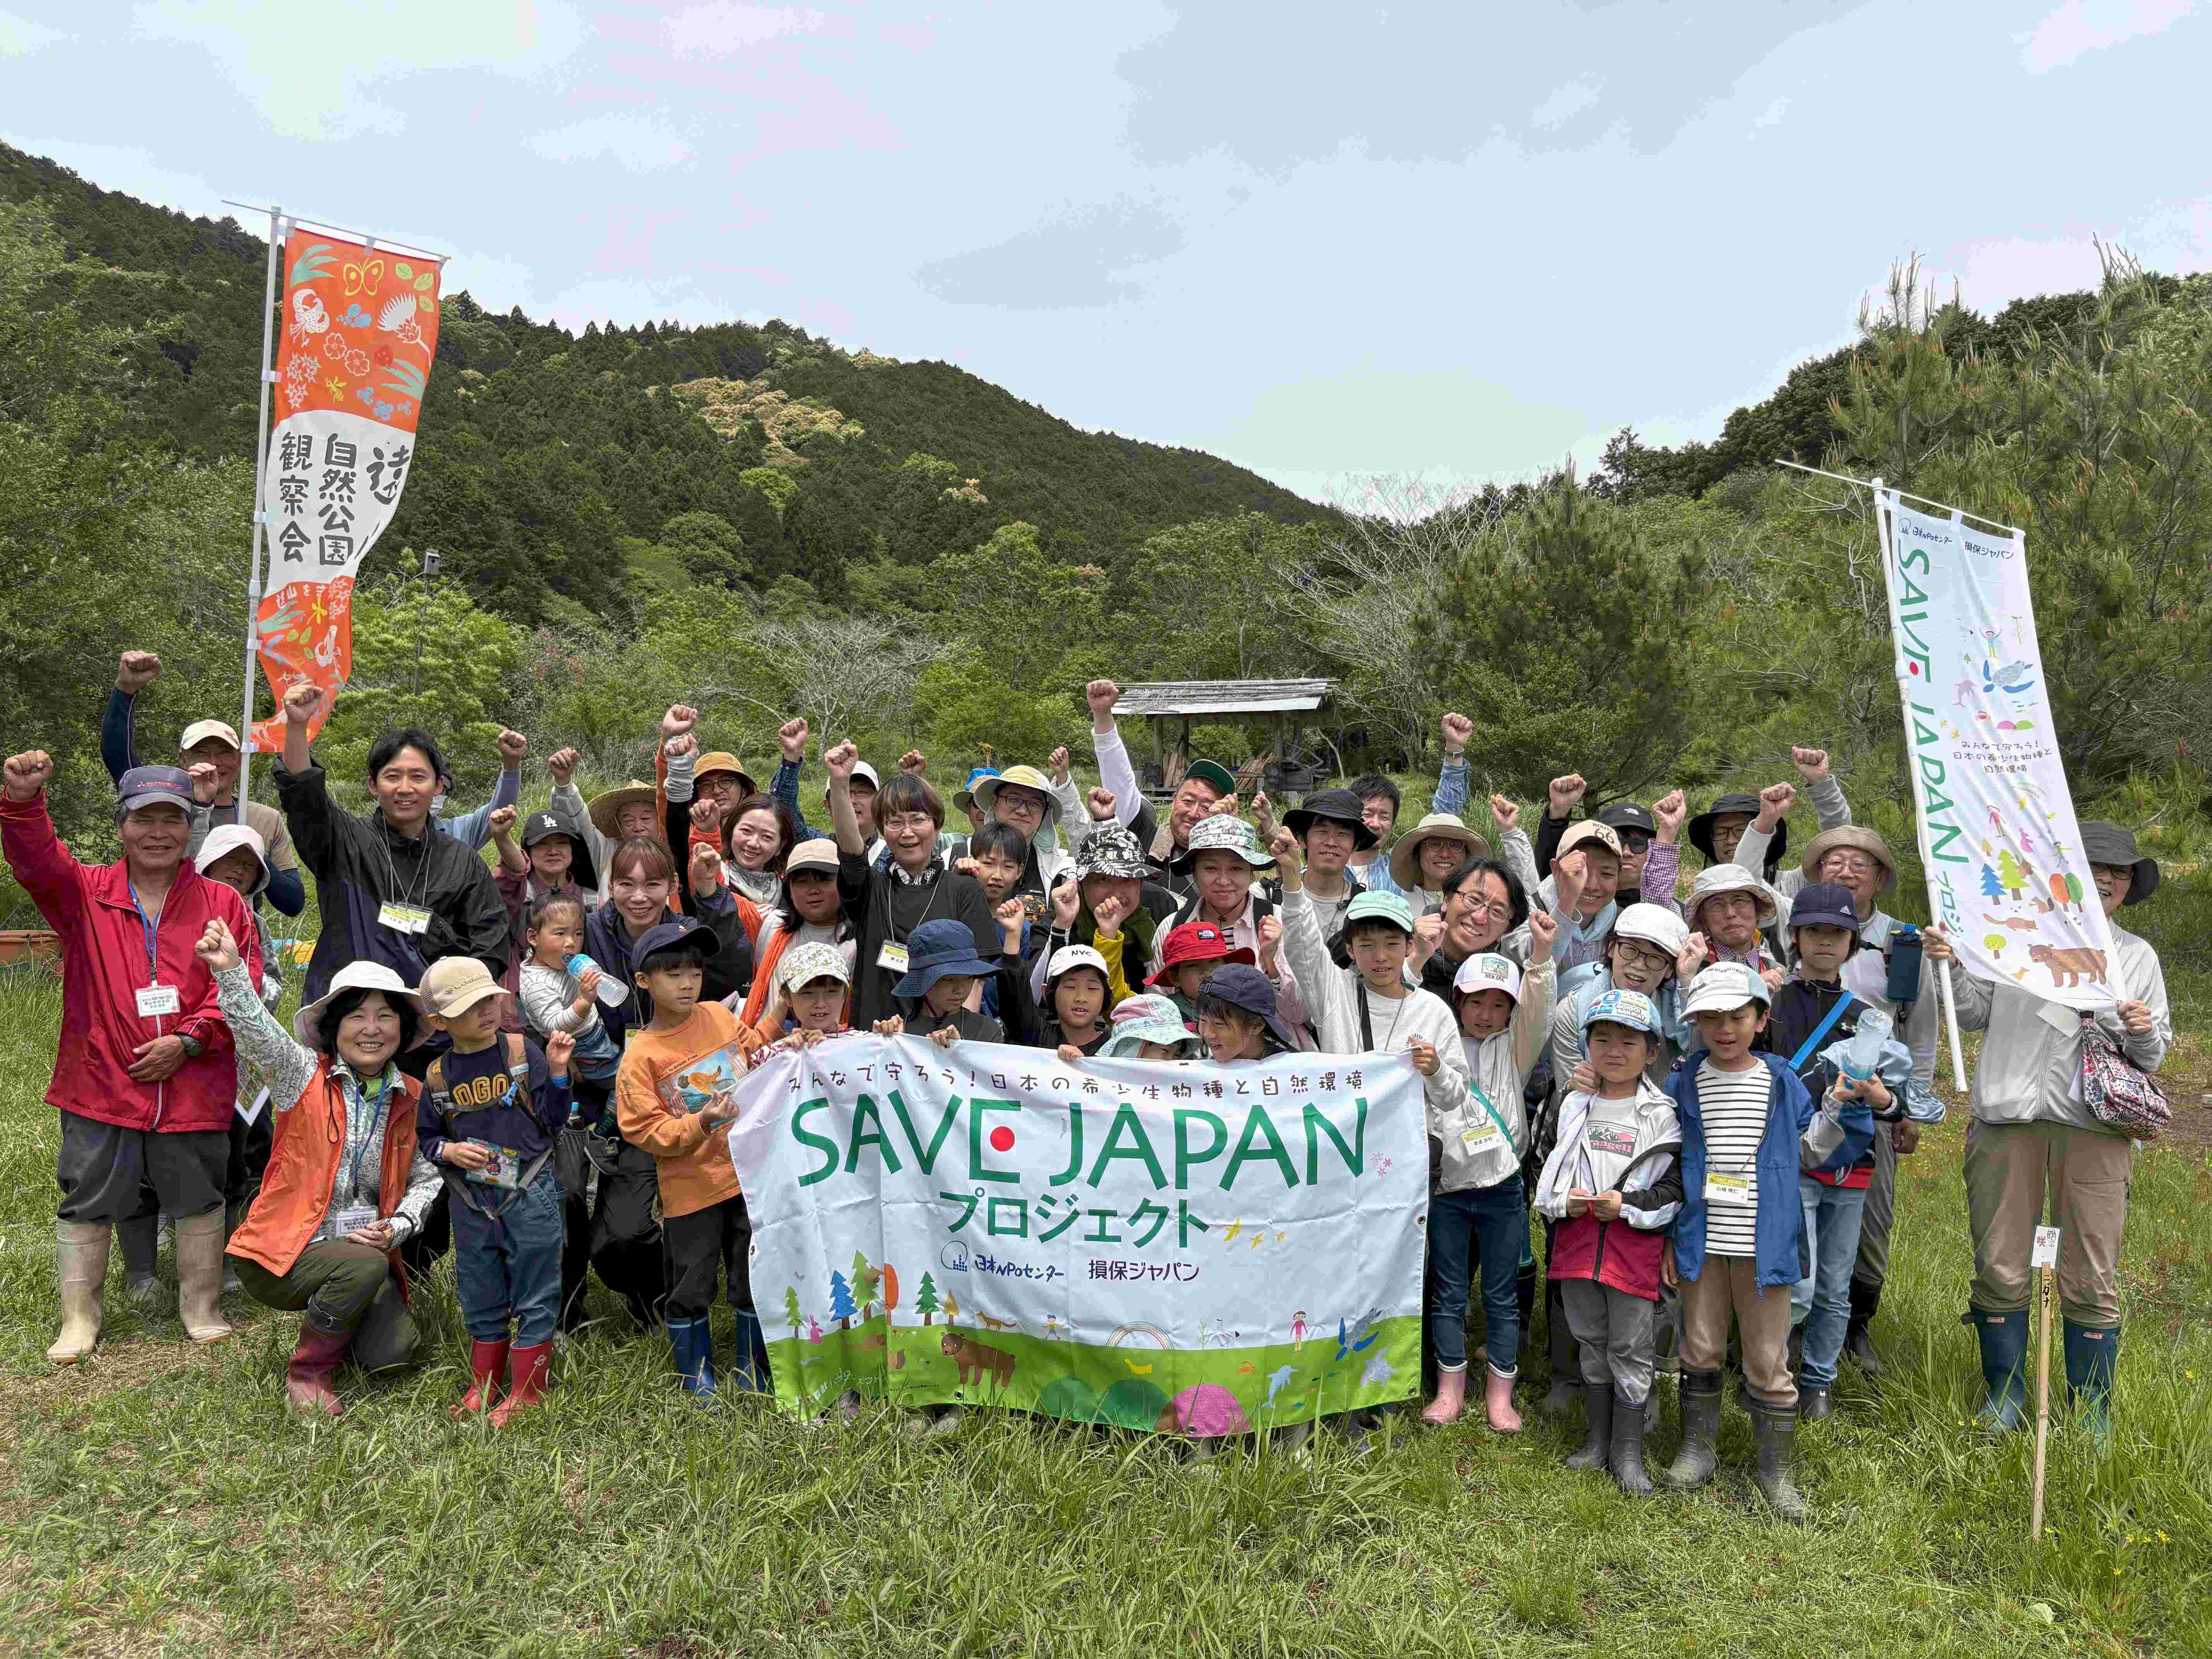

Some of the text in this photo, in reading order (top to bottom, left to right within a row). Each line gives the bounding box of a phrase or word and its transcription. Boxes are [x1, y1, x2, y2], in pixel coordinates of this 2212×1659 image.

[279, 431, 313, 562] 観察会
[318, 433, 357, 565] 自然公園
[1898, 537, 1931, 683] SAVE
[542, 815, 557, 827] LA
[1595, 828, 1614, 844] 66
[790, 1090, 1367, 1191] SAVE JAPAN
[939, 1187, 1209, 1249] プロジェクト
[975, 1254, 1065, 1283] 日本NPOセンター
[1089, 1259, 1200, 1281] 損保ジャパン
[2042, 1274, 2051, 1308] ニガナ
